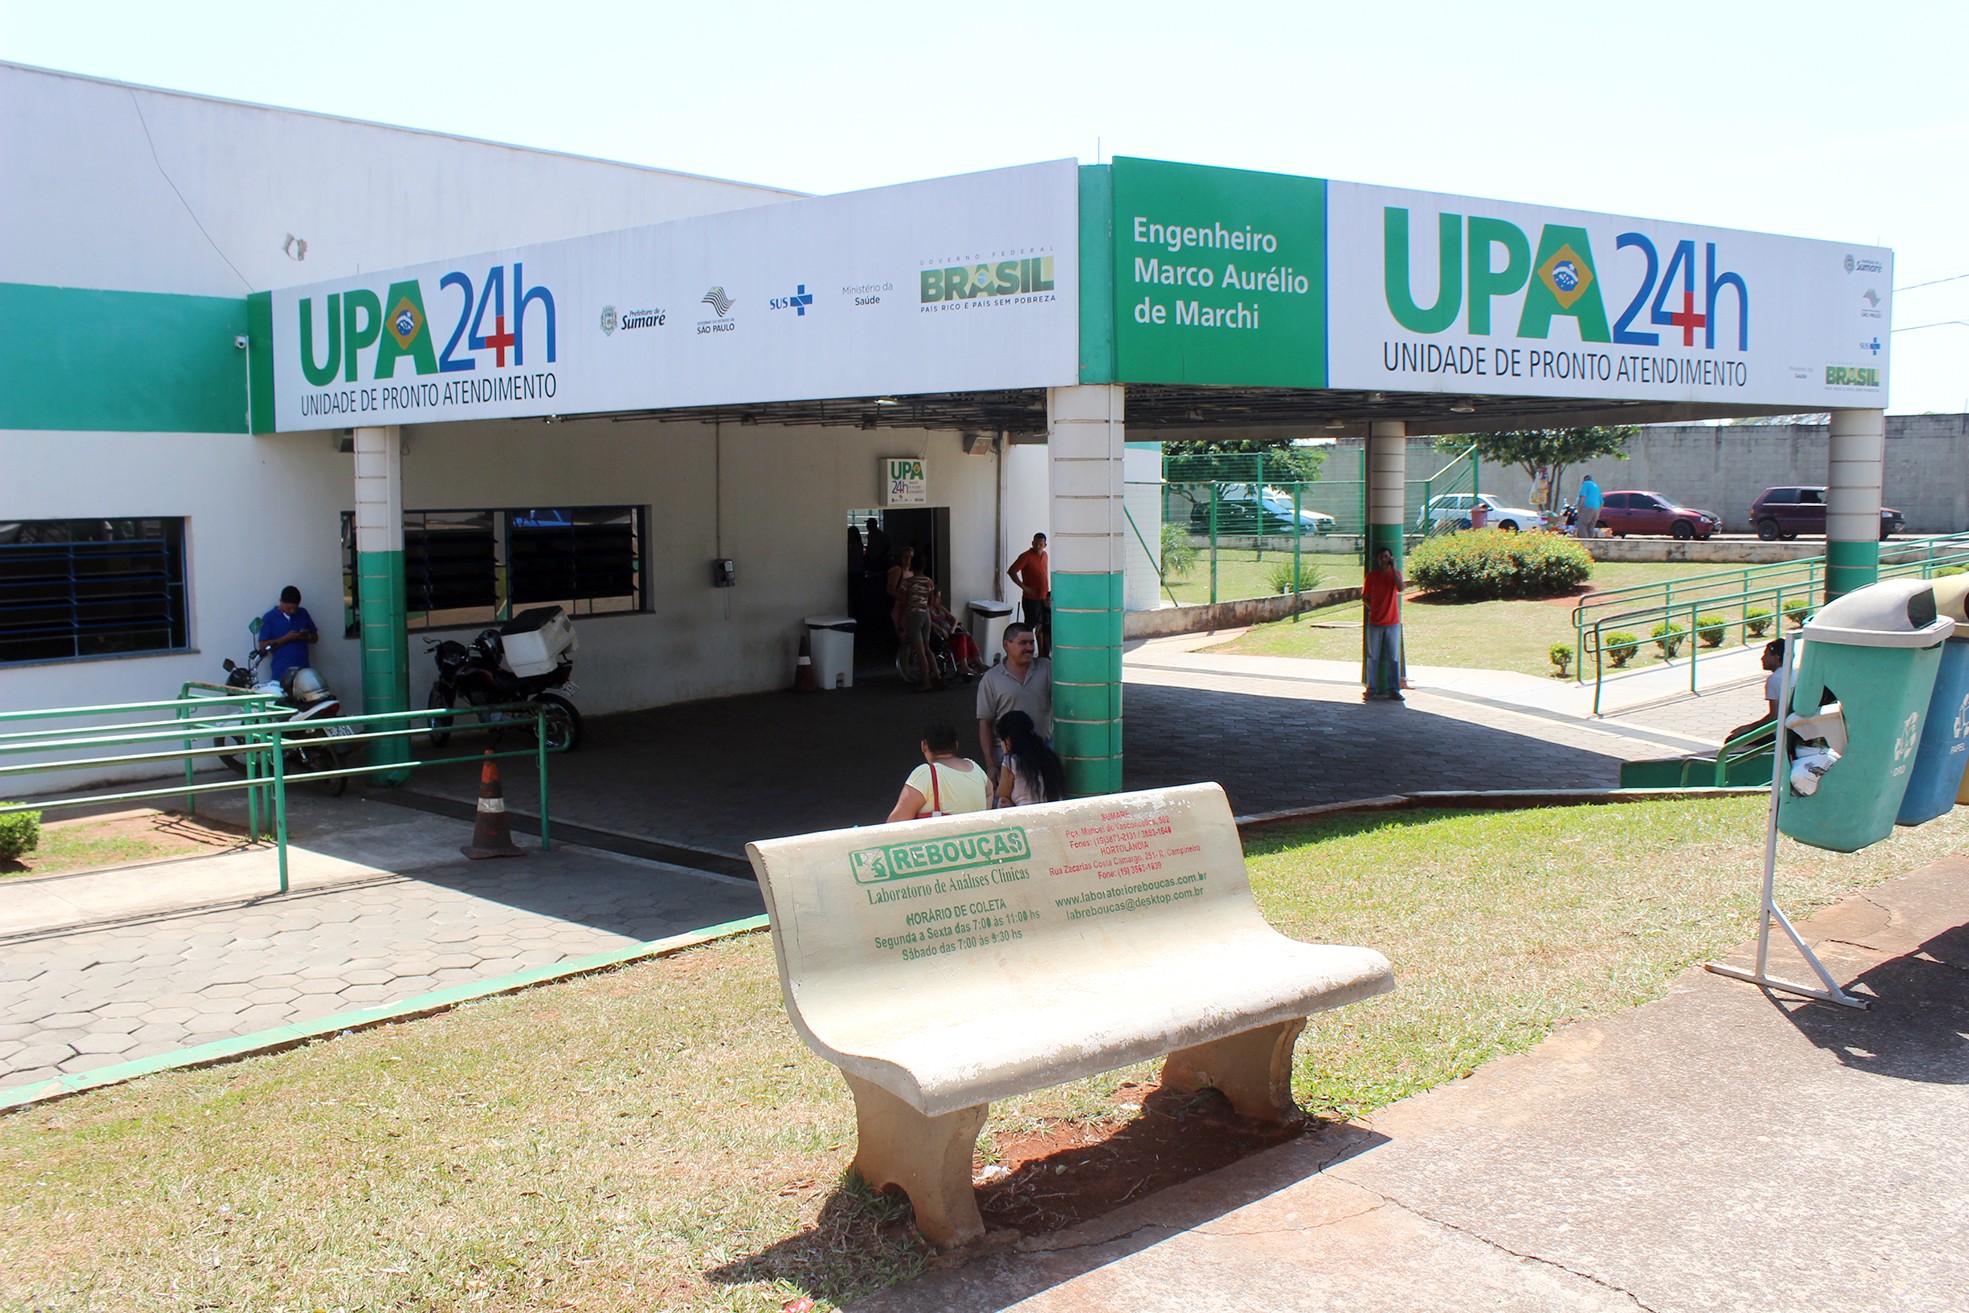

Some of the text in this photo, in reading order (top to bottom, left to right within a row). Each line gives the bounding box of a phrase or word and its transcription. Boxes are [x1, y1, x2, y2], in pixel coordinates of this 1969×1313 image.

[1134, 216, 1277, 253] Engenheiro
[920, 246, 1054, 266] GOVERNO FEDERAL
[842, 282, 893, 295] Ministério da
[921, 256, 1054, 304] BRASIL
[1135, 257, 1309, 294] Marco Aurélio
[1384, 206, 1748, 352] UPA 24h
[769, 297, 788, 310] SUS
[855, 295, 880, 306] Saúde
[921, 294, 1056, 313] PAÍS RICO E PAÍS SEM POBREZA
[1134, 296, 1259, 330] de Marchi
[299, 263, 556, 386] UPA 24h
[621, 309, 666, 330] Sumaré
[713, 323, 735, 333] PAULO
[1384, 341, 1748, 387] UNIDADE DE PRONTO ATENDIMENTO
[1826, 366, 1879, 387] BRASIL
[301, 373, 557, 416] UNIDADE DE PRONTO ATENDIMENTO
[891, 461, 923, 480] UPA
[892, 480, 908, 494] 24h
[893, 832, 1023, 870] REBOUÇAS
[935, 879, 947, 893] de
[949, 872, 989, 892] Análises
[991, 866, 1030, 884] Clínicas
[1049, 867, 1063, 876] Rua
[1063, 862, 1092, 873] Zacarias
[1097, 870, 1117, 879] Fone:
[1117, 867, 1130, 877] (19)
[906, 898, 1007, 926] HORÁRIO DE COLETA
[1066, 886, 1204, 921] labreboucas@desktop.com.br
[875, 909, 1040, 949] Segunda a Sexta das 7:00 às 11:00 hs
[902, 929, 1023, 960] Sábado das 7:00 às 9:30 hs
